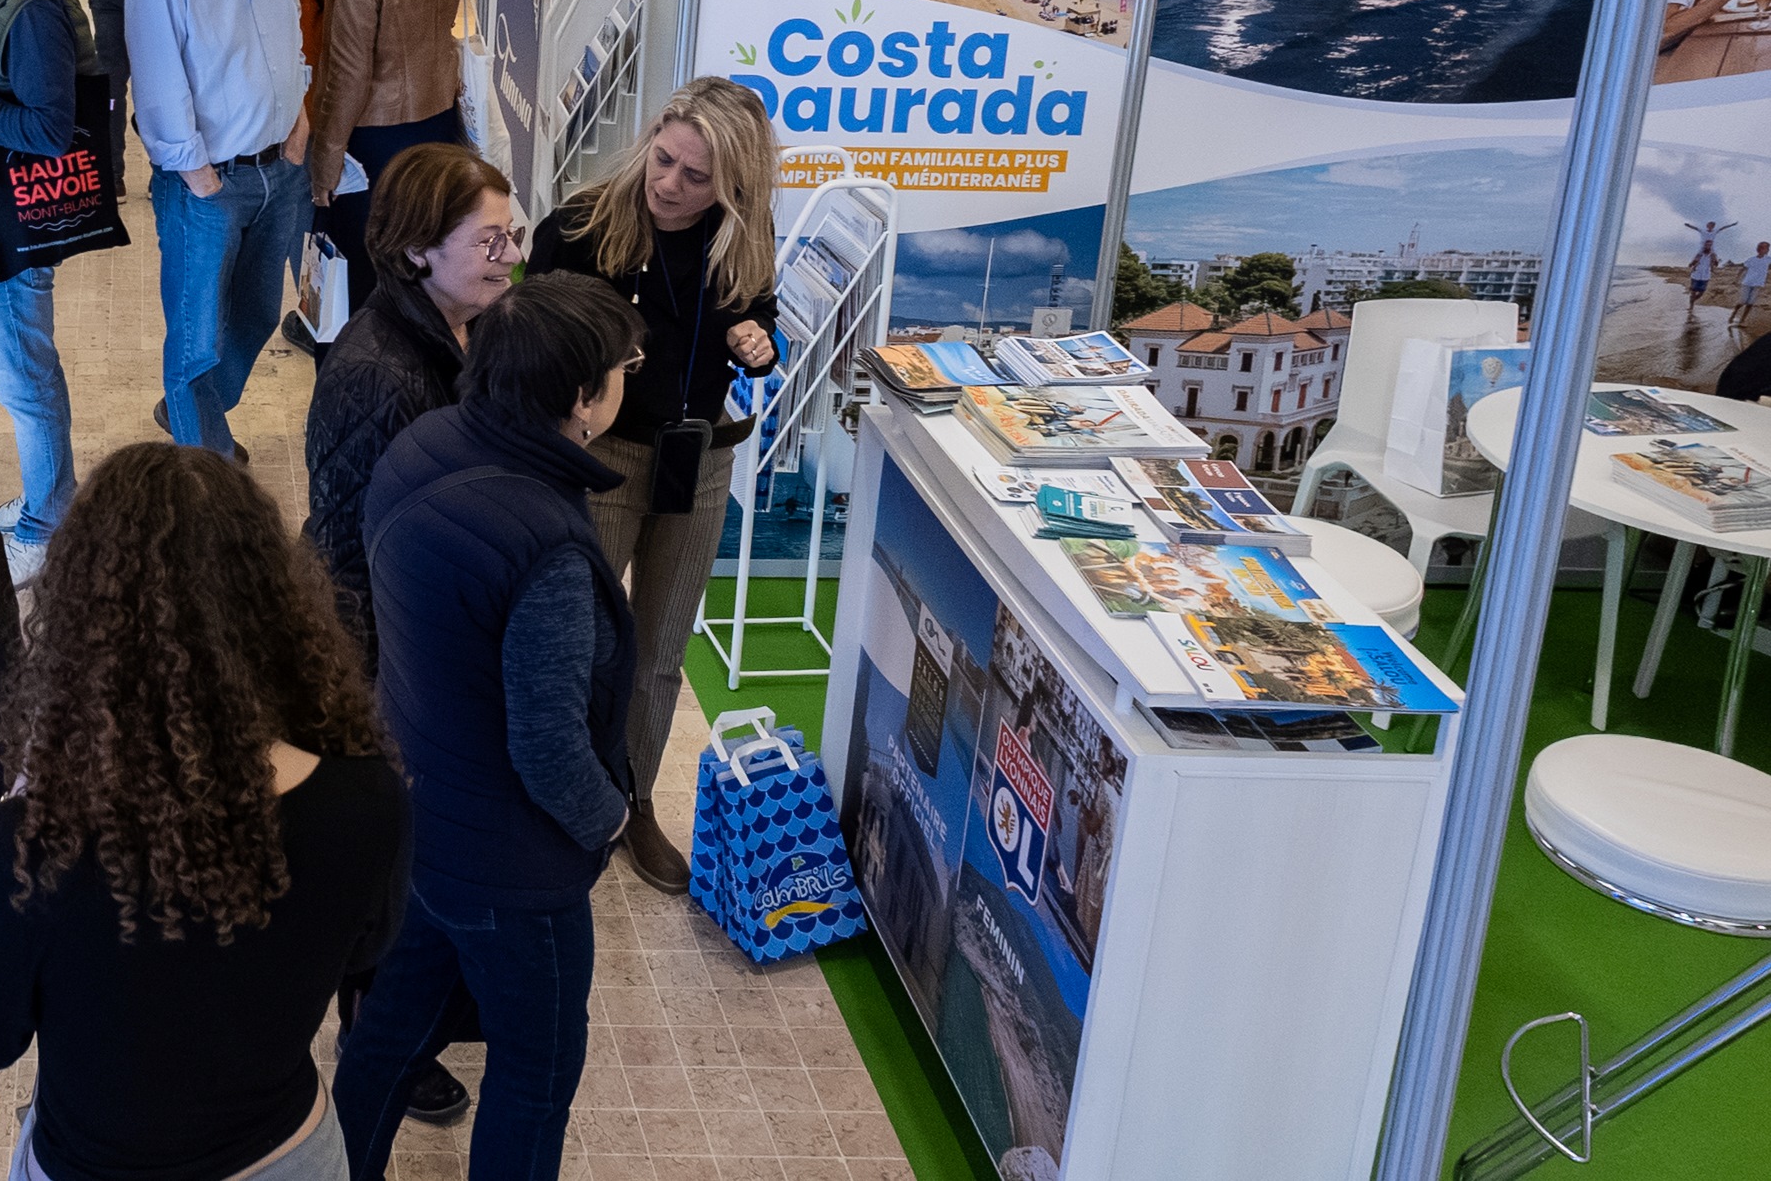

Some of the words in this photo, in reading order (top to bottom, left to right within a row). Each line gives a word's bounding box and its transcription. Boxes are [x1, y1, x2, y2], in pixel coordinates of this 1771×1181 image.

[766, 17, 1011, 80] Costa
[9, 149, 96, 186] HAUTE-
[889, 152, 986, 168] FAMILIALE
[987, 153, 1010, 168] LA
[1014, 154, 1060, 169] PLUS
[901, 168, 1042, 188] MÉDITERRANÉE
[13, 170, 101, 207] SAVOIE
[17, 193, 103, 223] MONT-BLANC
[1177, 637, 1216, 672] SALOU
[887, 734, 947, 843] PARTENAIRE
[998, 748, 1047, 824] LYONNAIS
[1001, 730, 1051, 803] OLYMPIQUE
[891, 768, 937, 850] OFFICIEL
[977, 893, 1026, 986] FEMININ
